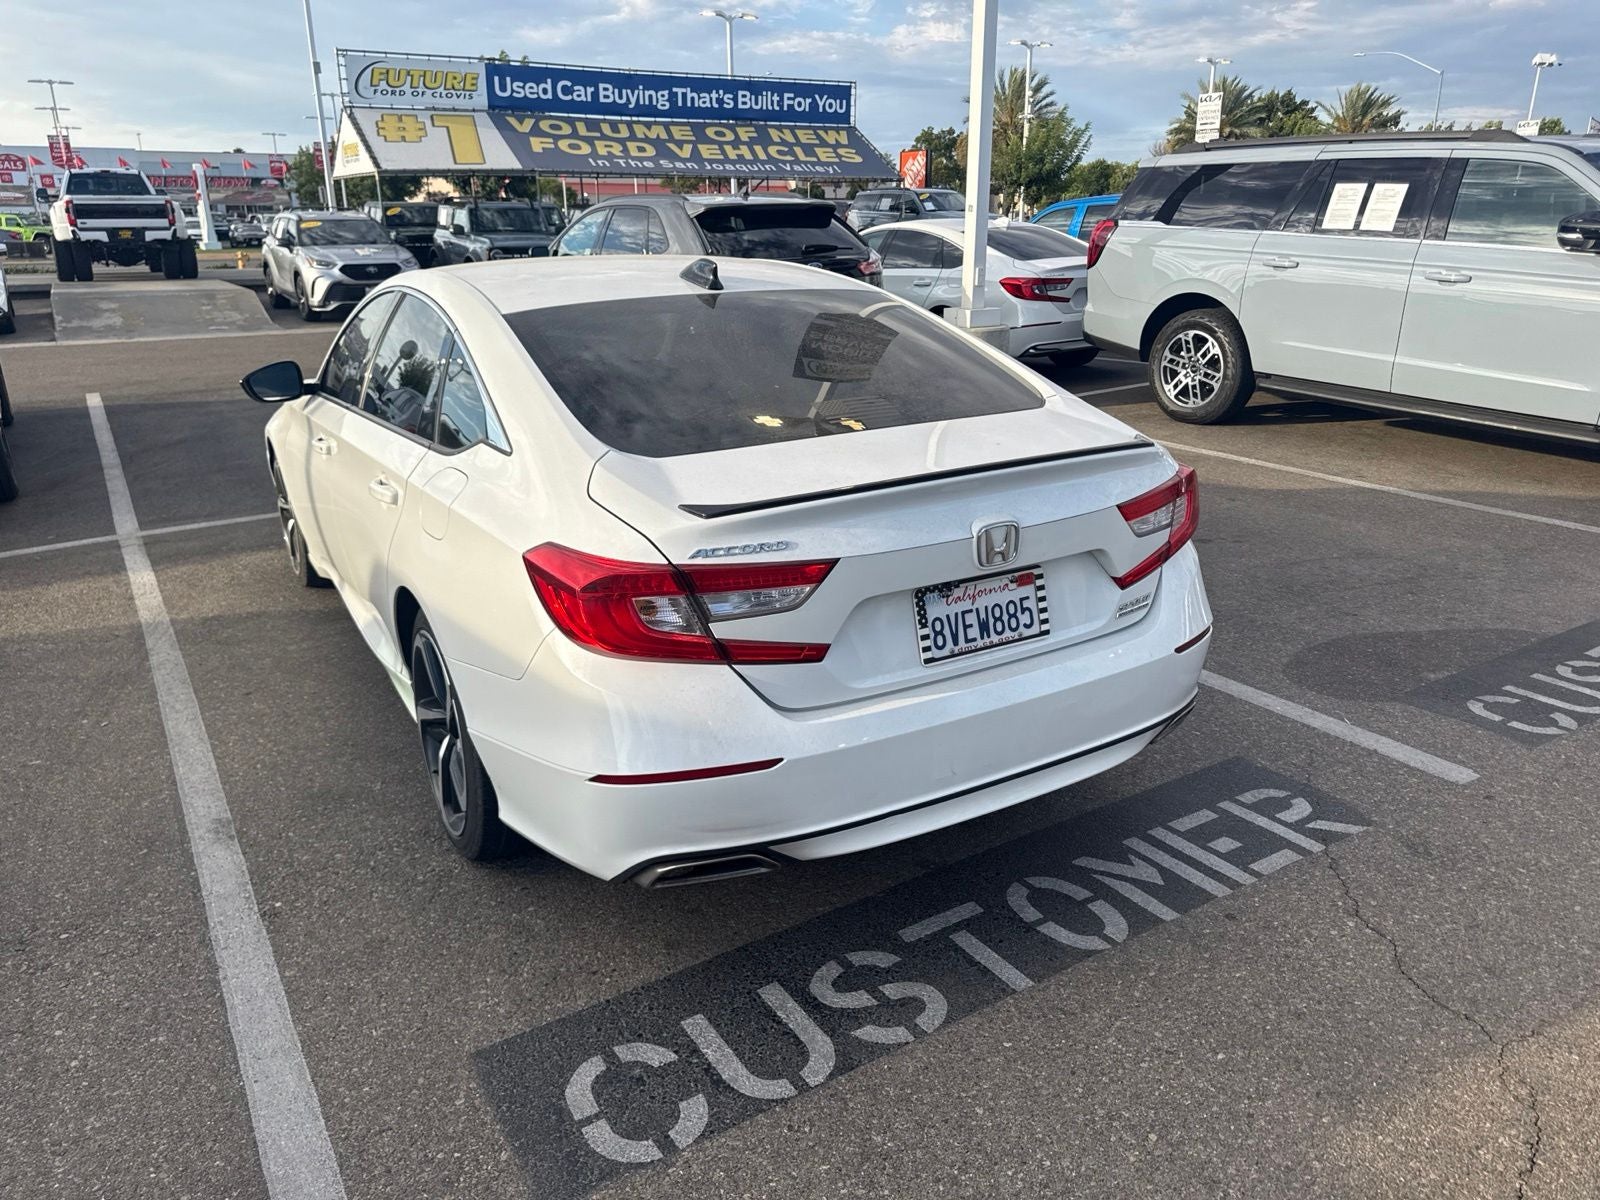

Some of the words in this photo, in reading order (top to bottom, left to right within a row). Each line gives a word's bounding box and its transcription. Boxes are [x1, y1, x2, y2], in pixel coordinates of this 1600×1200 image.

[370, 67, 479, 92] FUTURE
[373, 88, 406, 97] FORD
[411, 90, 427, 98] OF
[431, 91, 474, 100] CLOVIS
[493, 75, 553, 100] Used
[556, 80, 595, 102] Car
[598, 83, 671, 111] Buying
[672, 87, 734, 109] That's
[737, 90, 780, 111] Built
[783, 92, 812, 113] For
[814, 94, 847, 114] You
[376, 113, 486, 165] #1
[504, 115, 697, 142] VOLUME
[704, 126, 759, 142] OF
[766, 127, 849, 145] NEW
[528, 136, 657, 157] FORD
[666, 142, 864, 163] VEHICLES
[588, 158, 611, 168] In
[613, 159, 656, 168] The
[658, 160, 699, 170] San
[704, 162, 777, 173] Joaquin
[777, 162, 842, 175] Valley!
[688, 540, 794, 559] ACCORD
[945, 582, 1015, 606] California
[930, 595, 1035, 651] 8VEW885
[957, 635, 1016, 655] dmv.ca.gov
[1466, 646, 1600, 735] CUS
[564, 788, 1372, 1165] CUSTOMER
